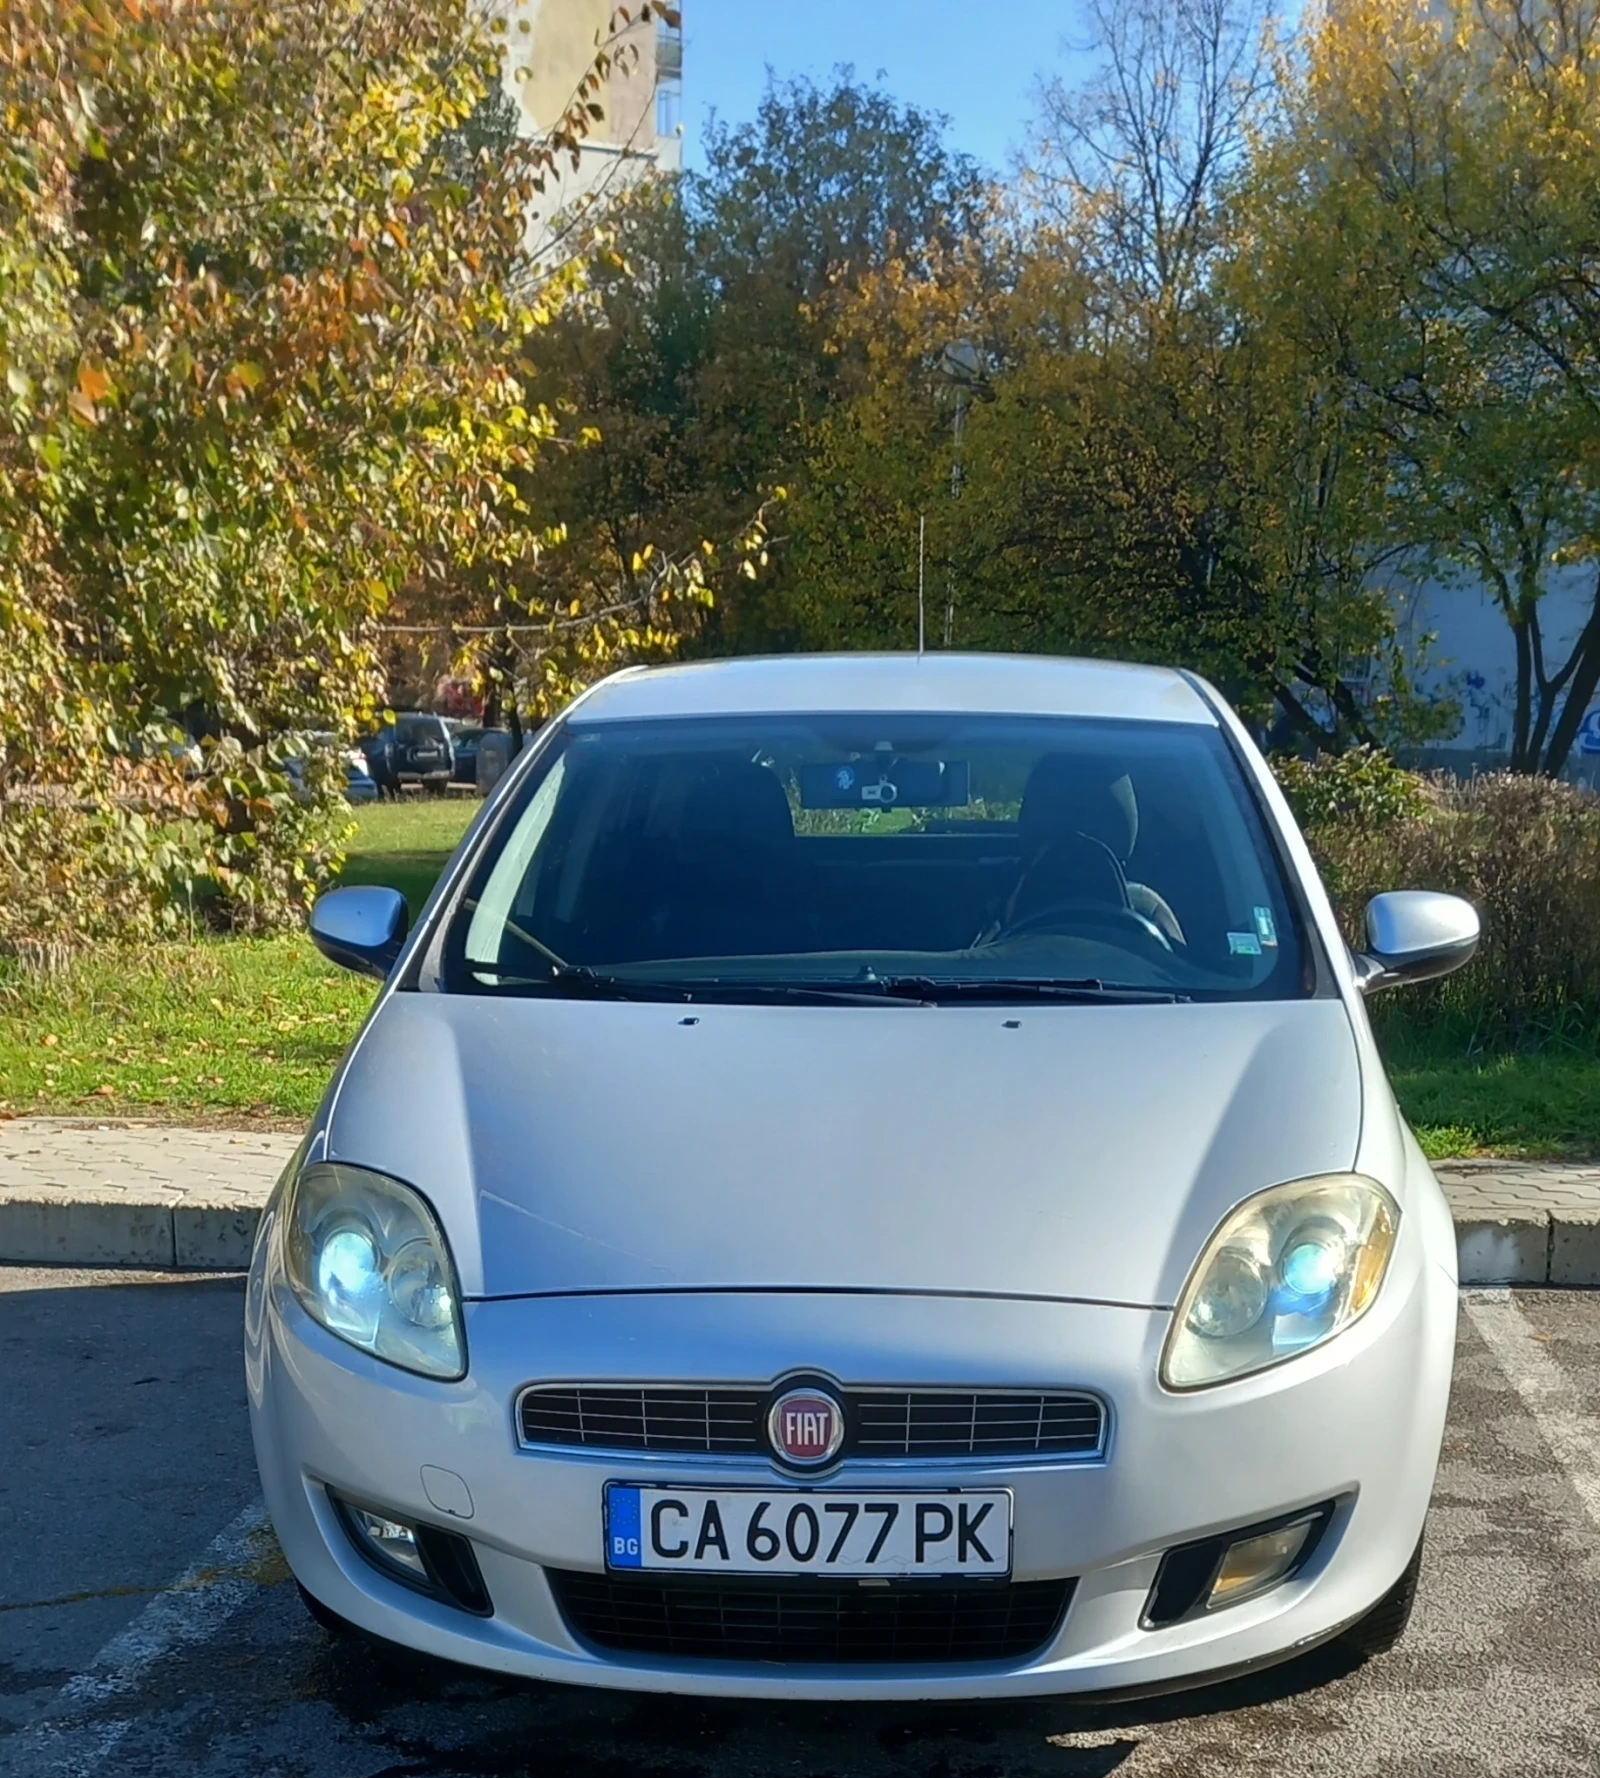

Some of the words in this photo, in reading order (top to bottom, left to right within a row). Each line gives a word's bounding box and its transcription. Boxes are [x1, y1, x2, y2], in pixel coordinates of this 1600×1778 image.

[786, 1412, 828, 1446] FIAT
[614, 1537, 639, 1555] BG
[651, 1499, 730, 1560] CA
[746, 1502, 899, 1563] 6077
[915, 1503, 995, 1563] PK
